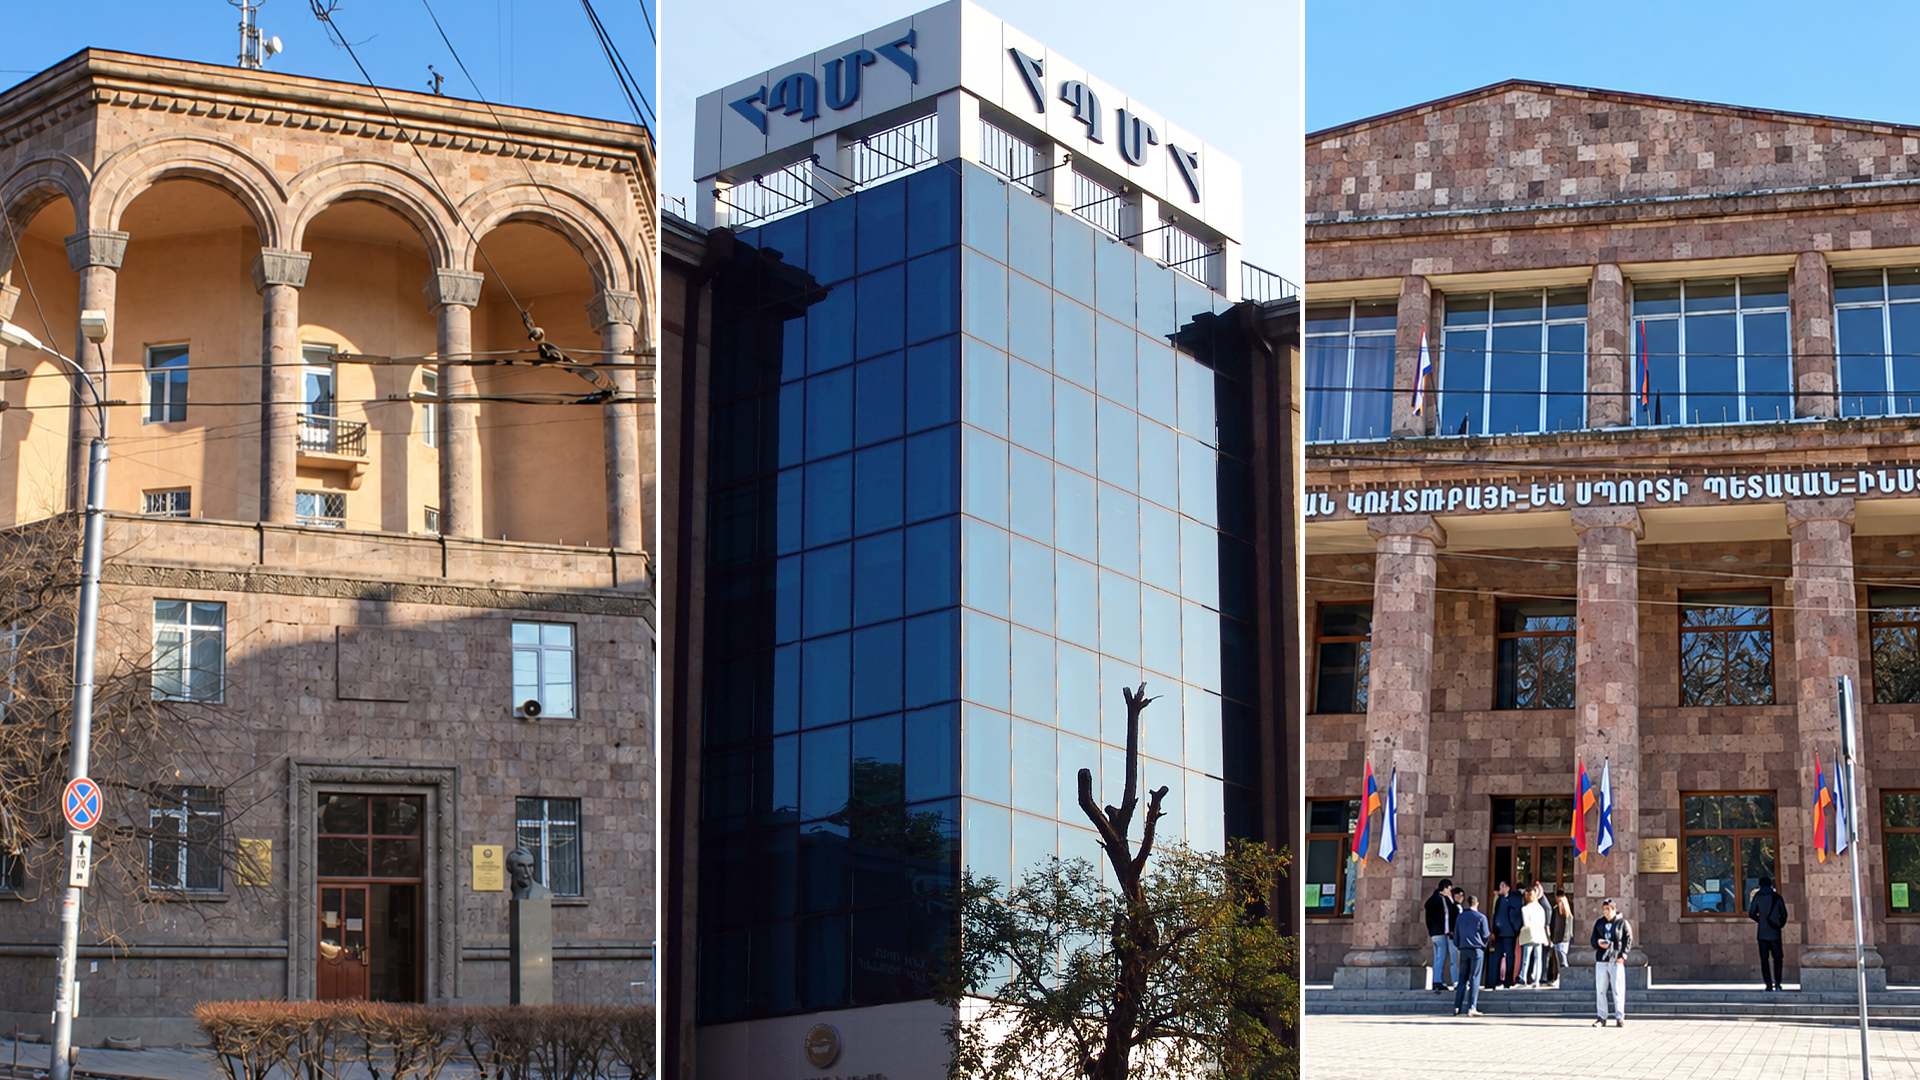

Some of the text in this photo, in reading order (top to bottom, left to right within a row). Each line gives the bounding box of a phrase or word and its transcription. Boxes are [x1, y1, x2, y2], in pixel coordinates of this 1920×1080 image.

[728, 29, 918, 135] ՀՊՄՀ
[1008, 47, 1200, 204] ՀՊՄՀ
[1858, 467, 1920, 494] ԻՆՍ
